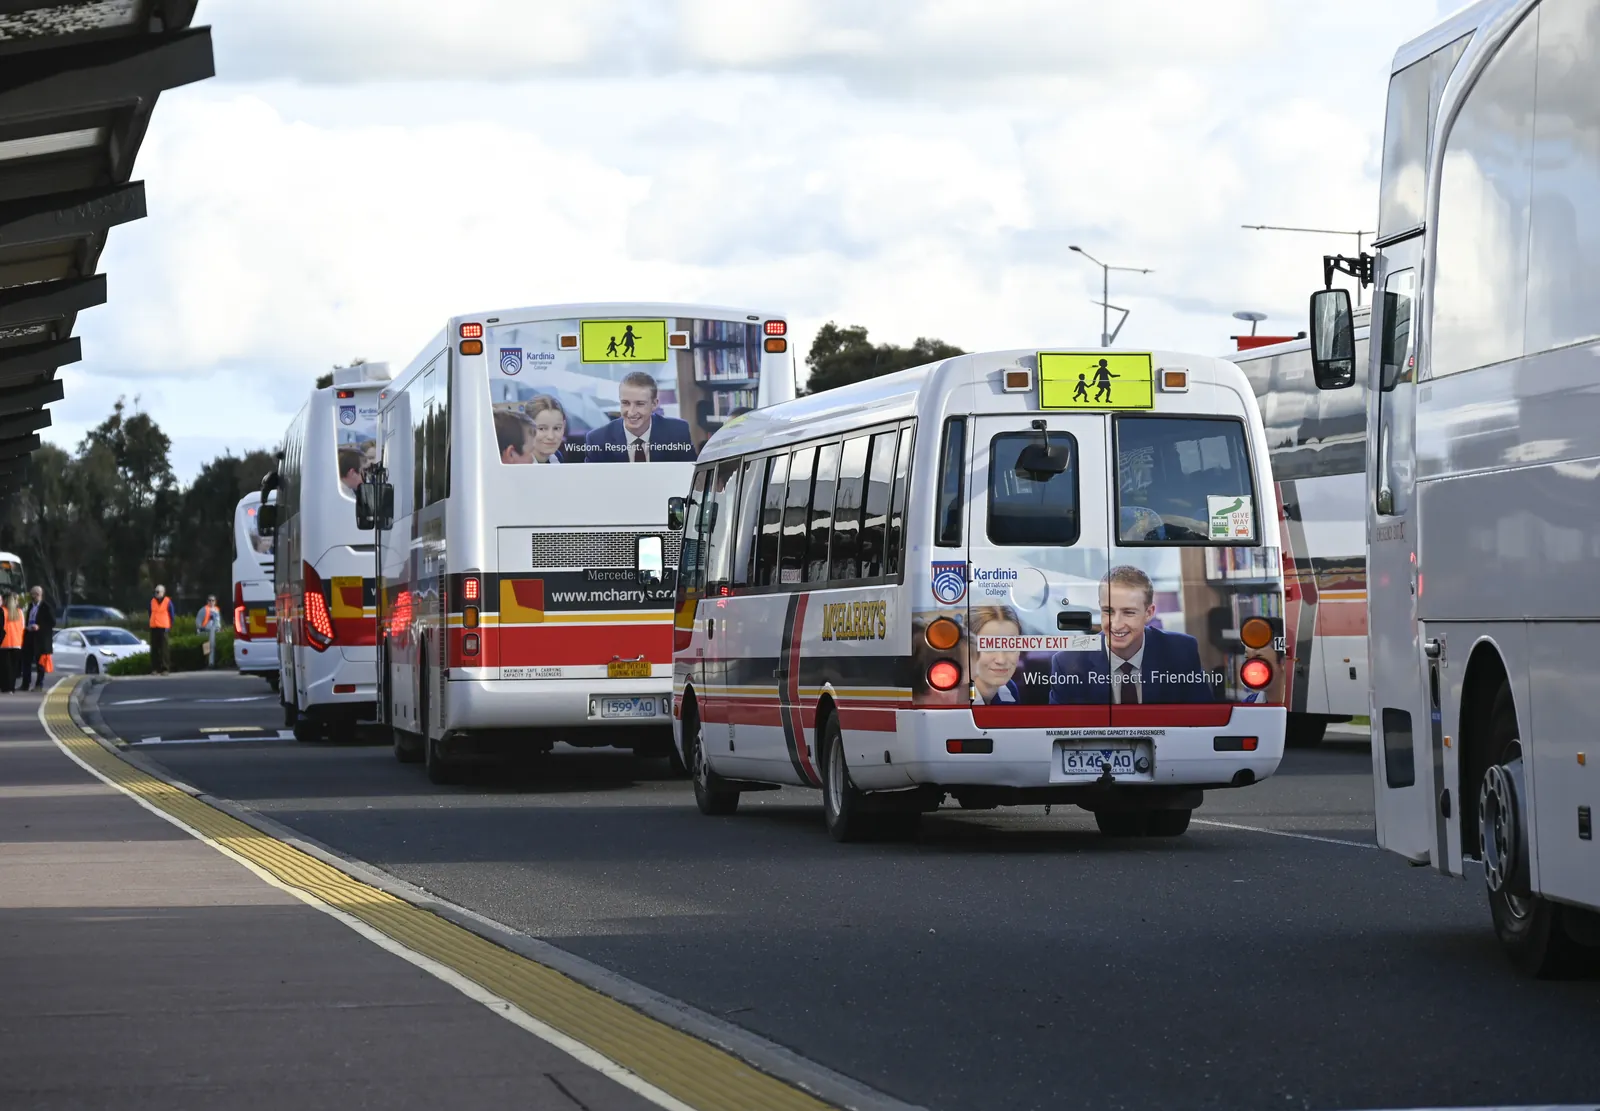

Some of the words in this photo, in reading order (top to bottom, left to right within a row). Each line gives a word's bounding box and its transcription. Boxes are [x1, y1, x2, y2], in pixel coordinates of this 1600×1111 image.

[526, 352, 555, 360] Kardinia
[564, 443, 602, 452] Wisdom.
[604, 442, 642, 453] Respect.
[645, 441, 692, 453] Friendship
[973, 567, 1018, 580] Kardinia
[978, 580, 1014, 588] International
[985, 588, 1007, 596] College
[979, 637, 1043, 649] EMERGENCY
[1045, 637, 1069, 649] EXIT
[1023, 672, 1084, 685] Wisdom.
[1088, 671, 1146, 686] Respect.
[1151, 670, 1223, 686] Friendship
[607, 702, 633, 712] 1599
[1068, 755, 1104, 768] 6146
